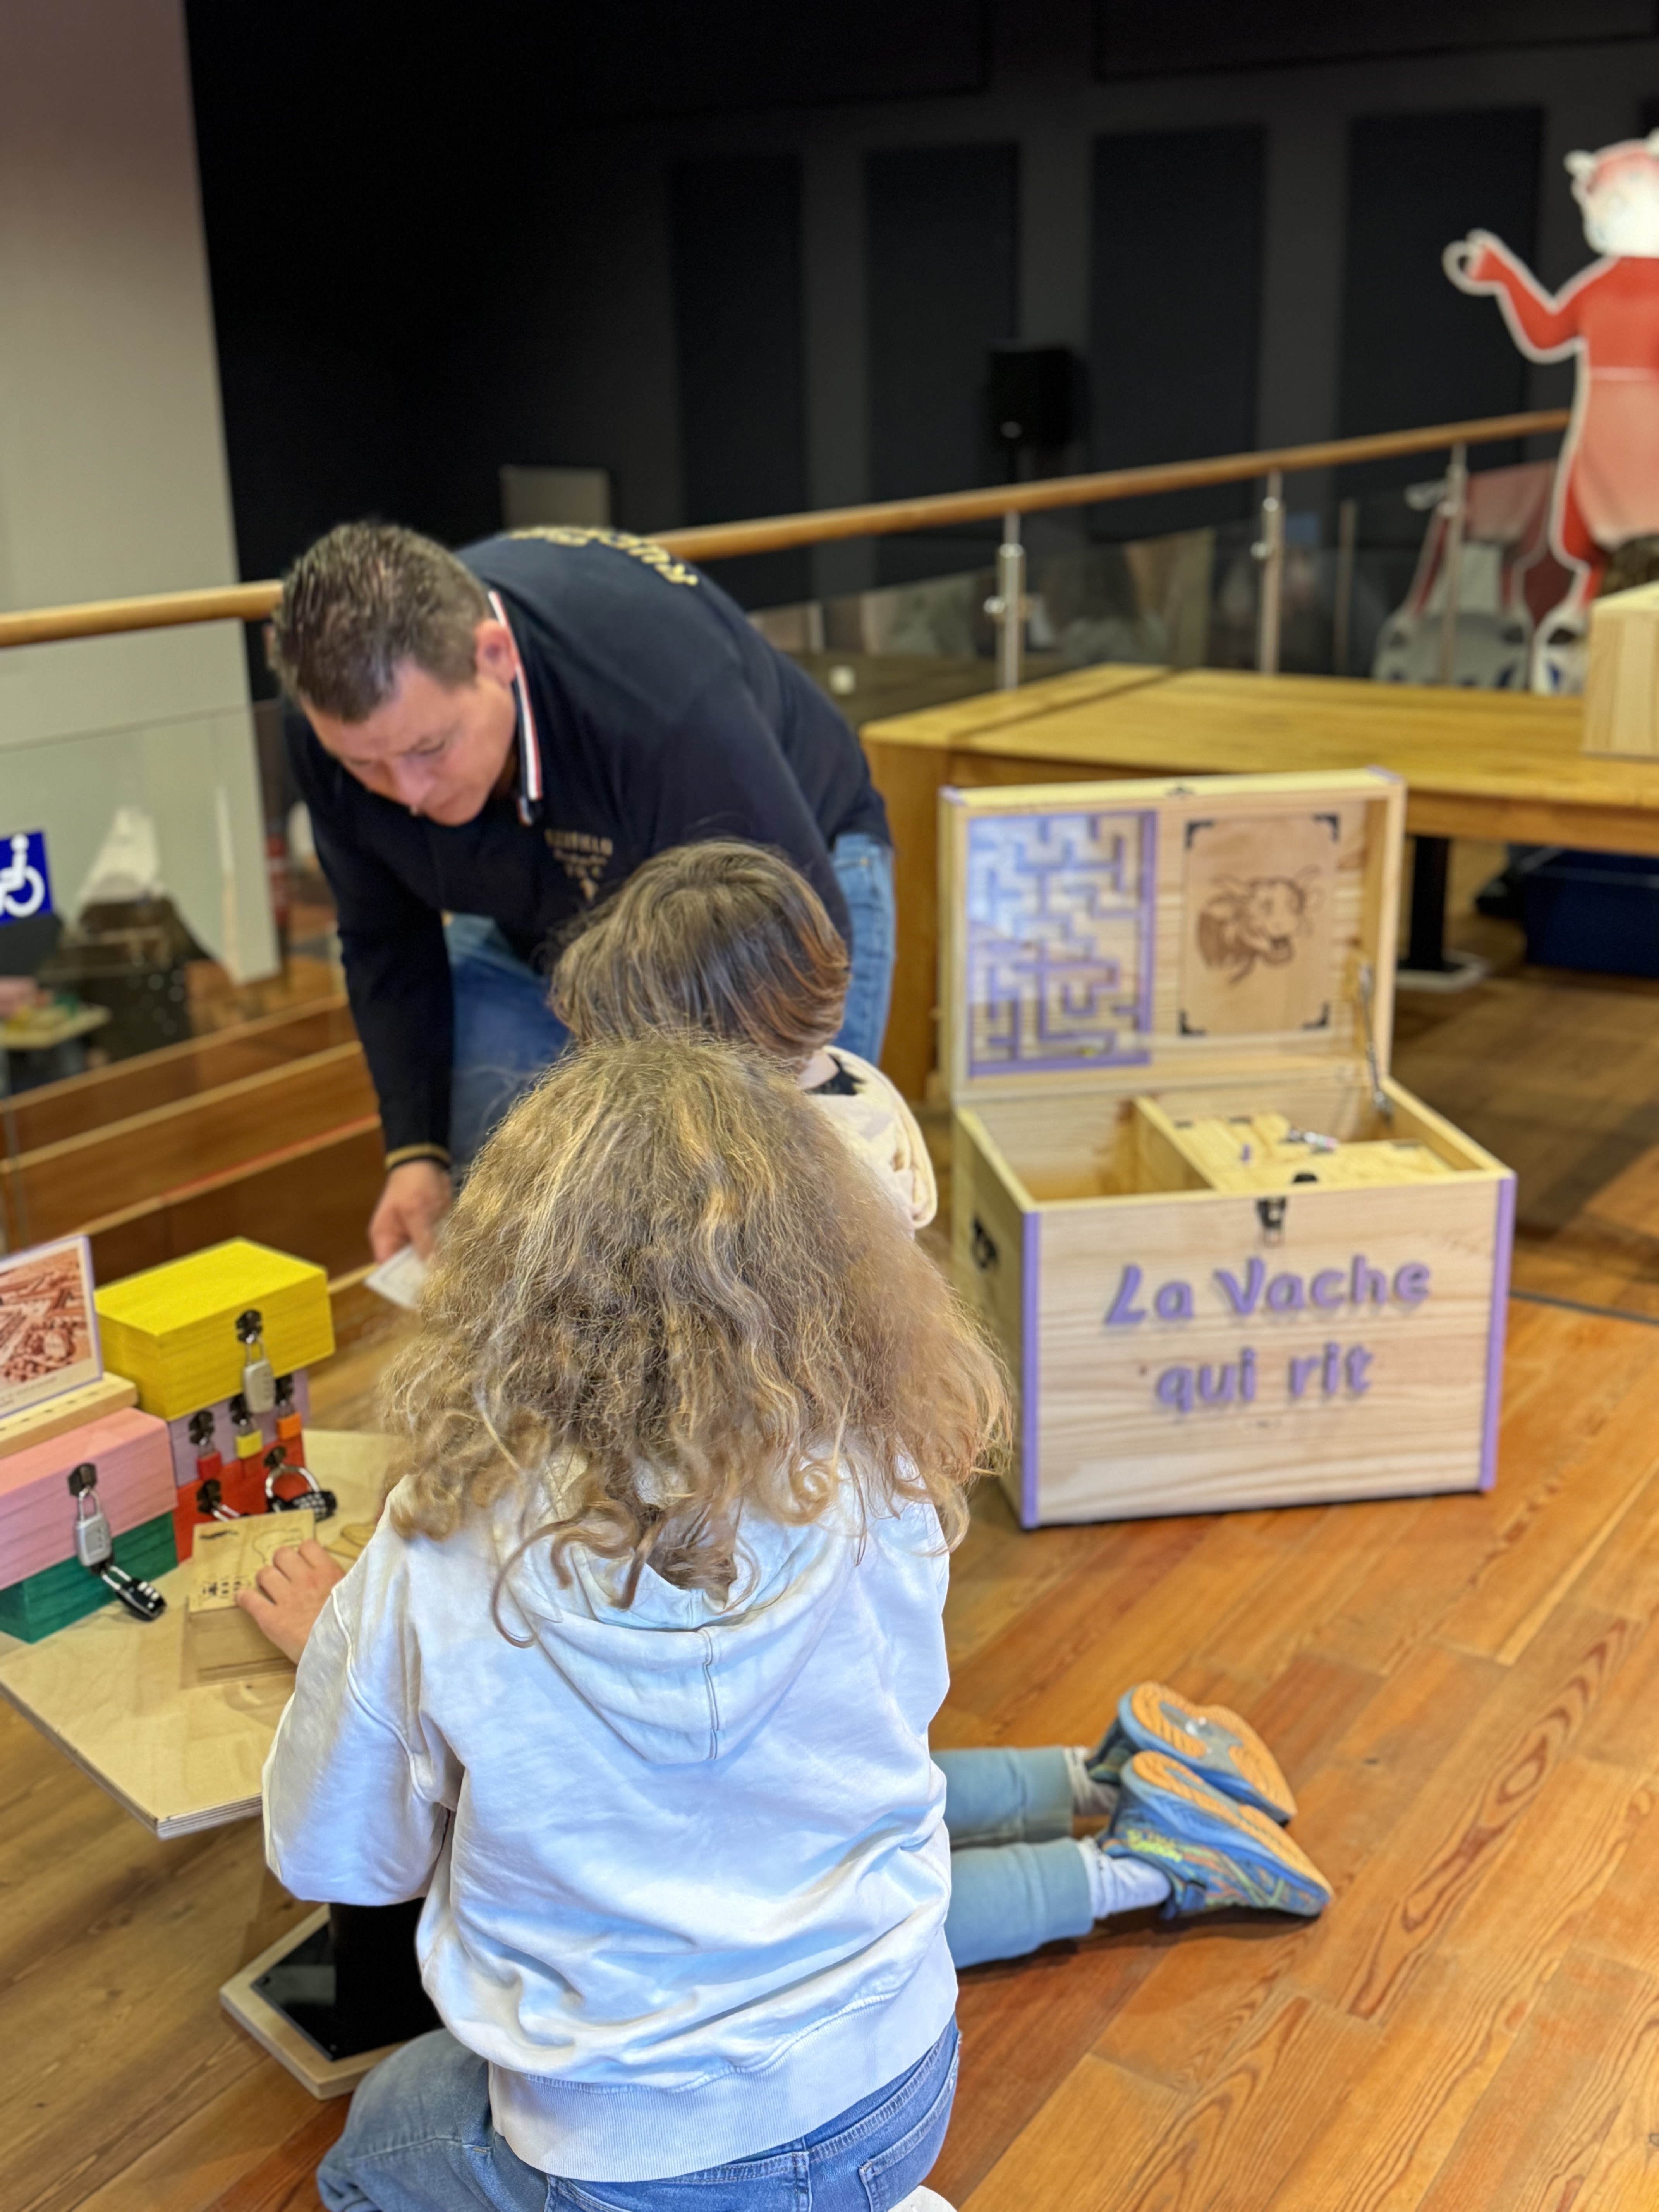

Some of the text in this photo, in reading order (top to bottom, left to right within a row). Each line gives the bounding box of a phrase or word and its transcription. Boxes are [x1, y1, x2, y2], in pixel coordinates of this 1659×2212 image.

[1104, 1255, 1431, 1324] La Vache
[1156, 1342, 1373, 1413] qui rit
